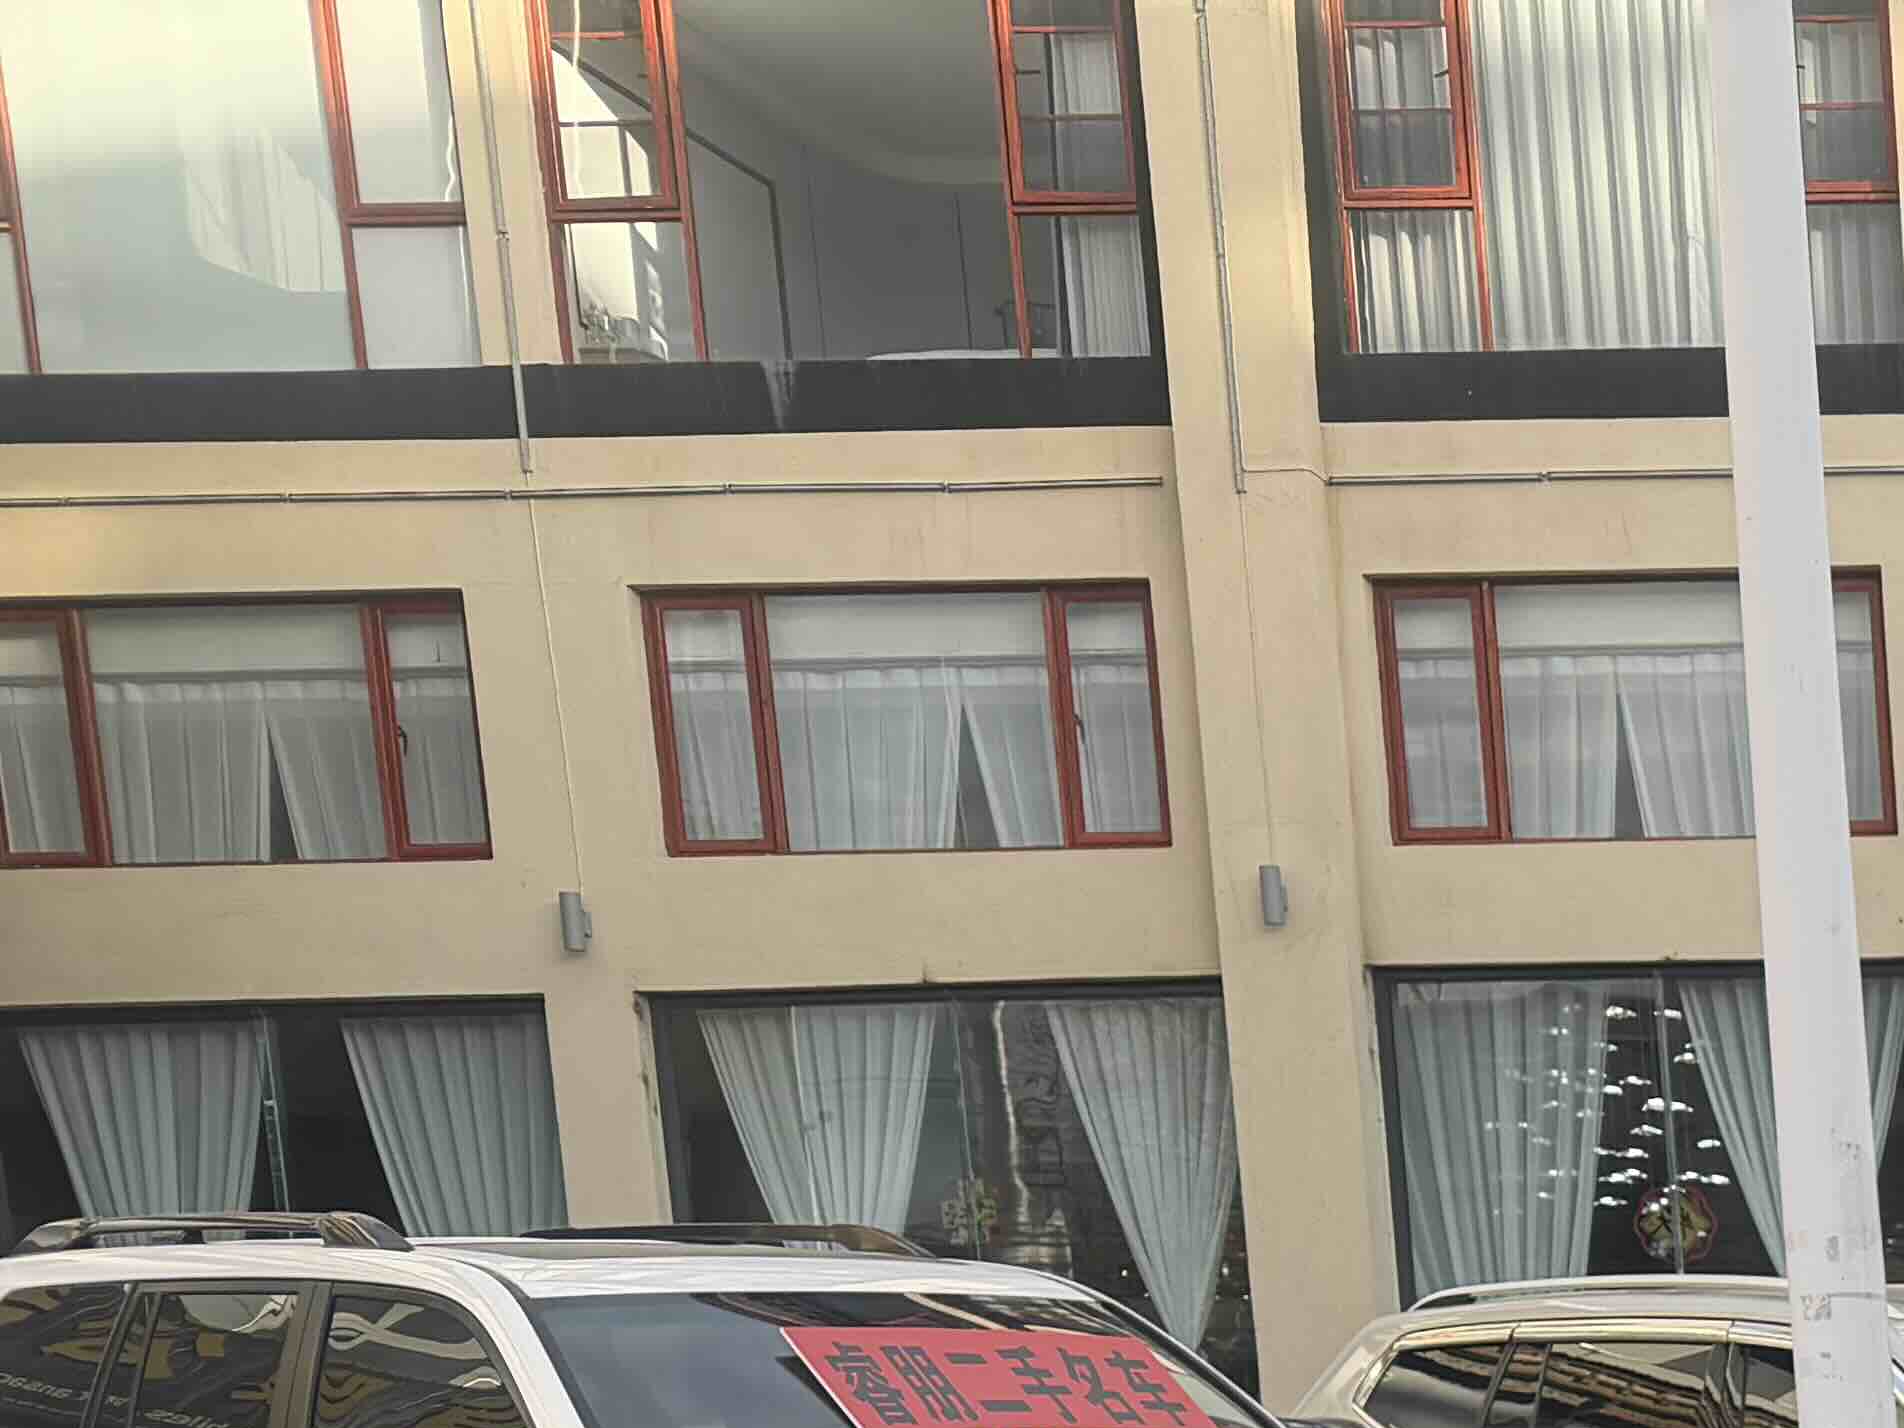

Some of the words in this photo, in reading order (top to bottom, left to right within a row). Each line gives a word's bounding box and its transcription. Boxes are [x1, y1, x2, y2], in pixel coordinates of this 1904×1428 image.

[824, 1341, 1192, 1426] 睿朋二手名车
